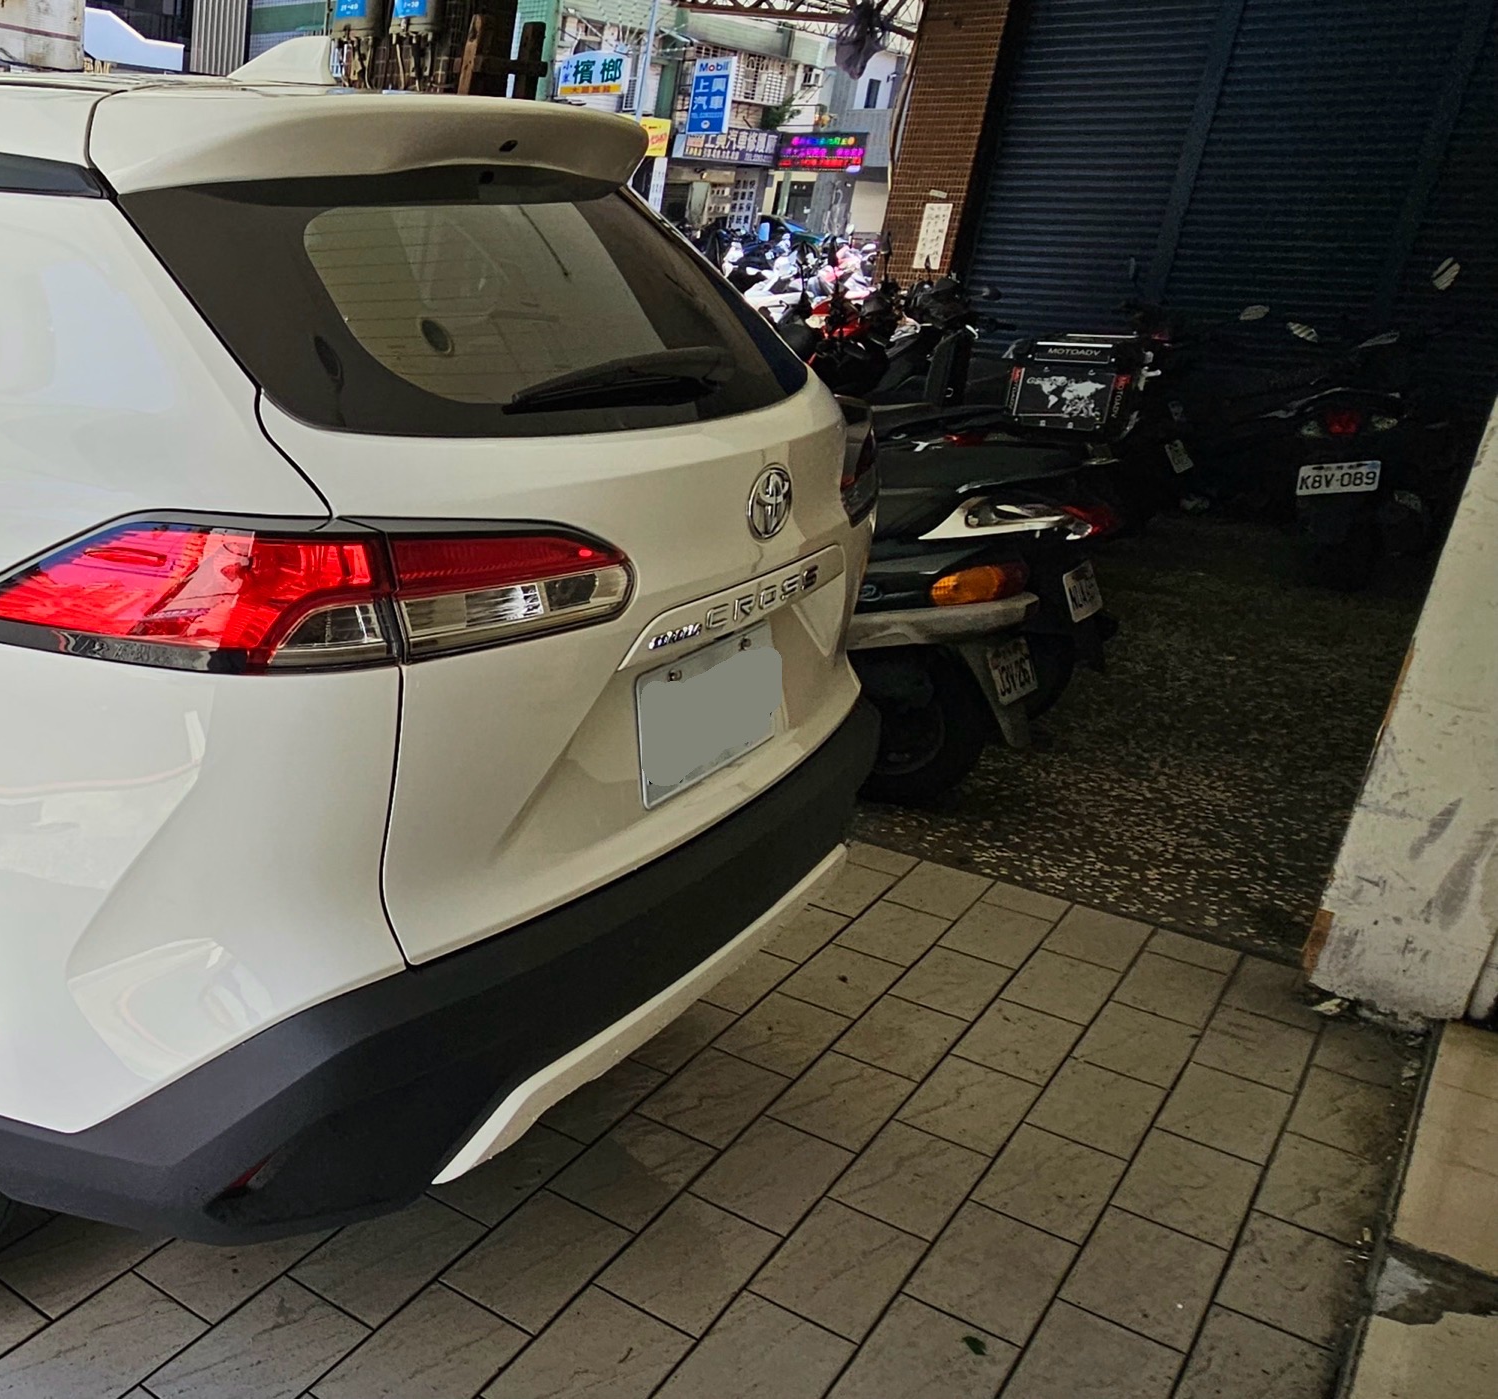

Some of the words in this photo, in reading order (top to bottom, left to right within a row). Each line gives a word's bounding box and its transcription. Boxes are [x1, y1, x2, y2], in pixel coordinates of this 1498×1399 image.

[573, 58, 623, 84] 檳榔
[700, 61, 729, 72] Mobil
[693, 95, 724, 110] 汽車
[1047, 347, 1102, 357] MOTOADV
[1299, 471, 1377, 491] K8V-089
[705, 565, 819, 630] CROSS
